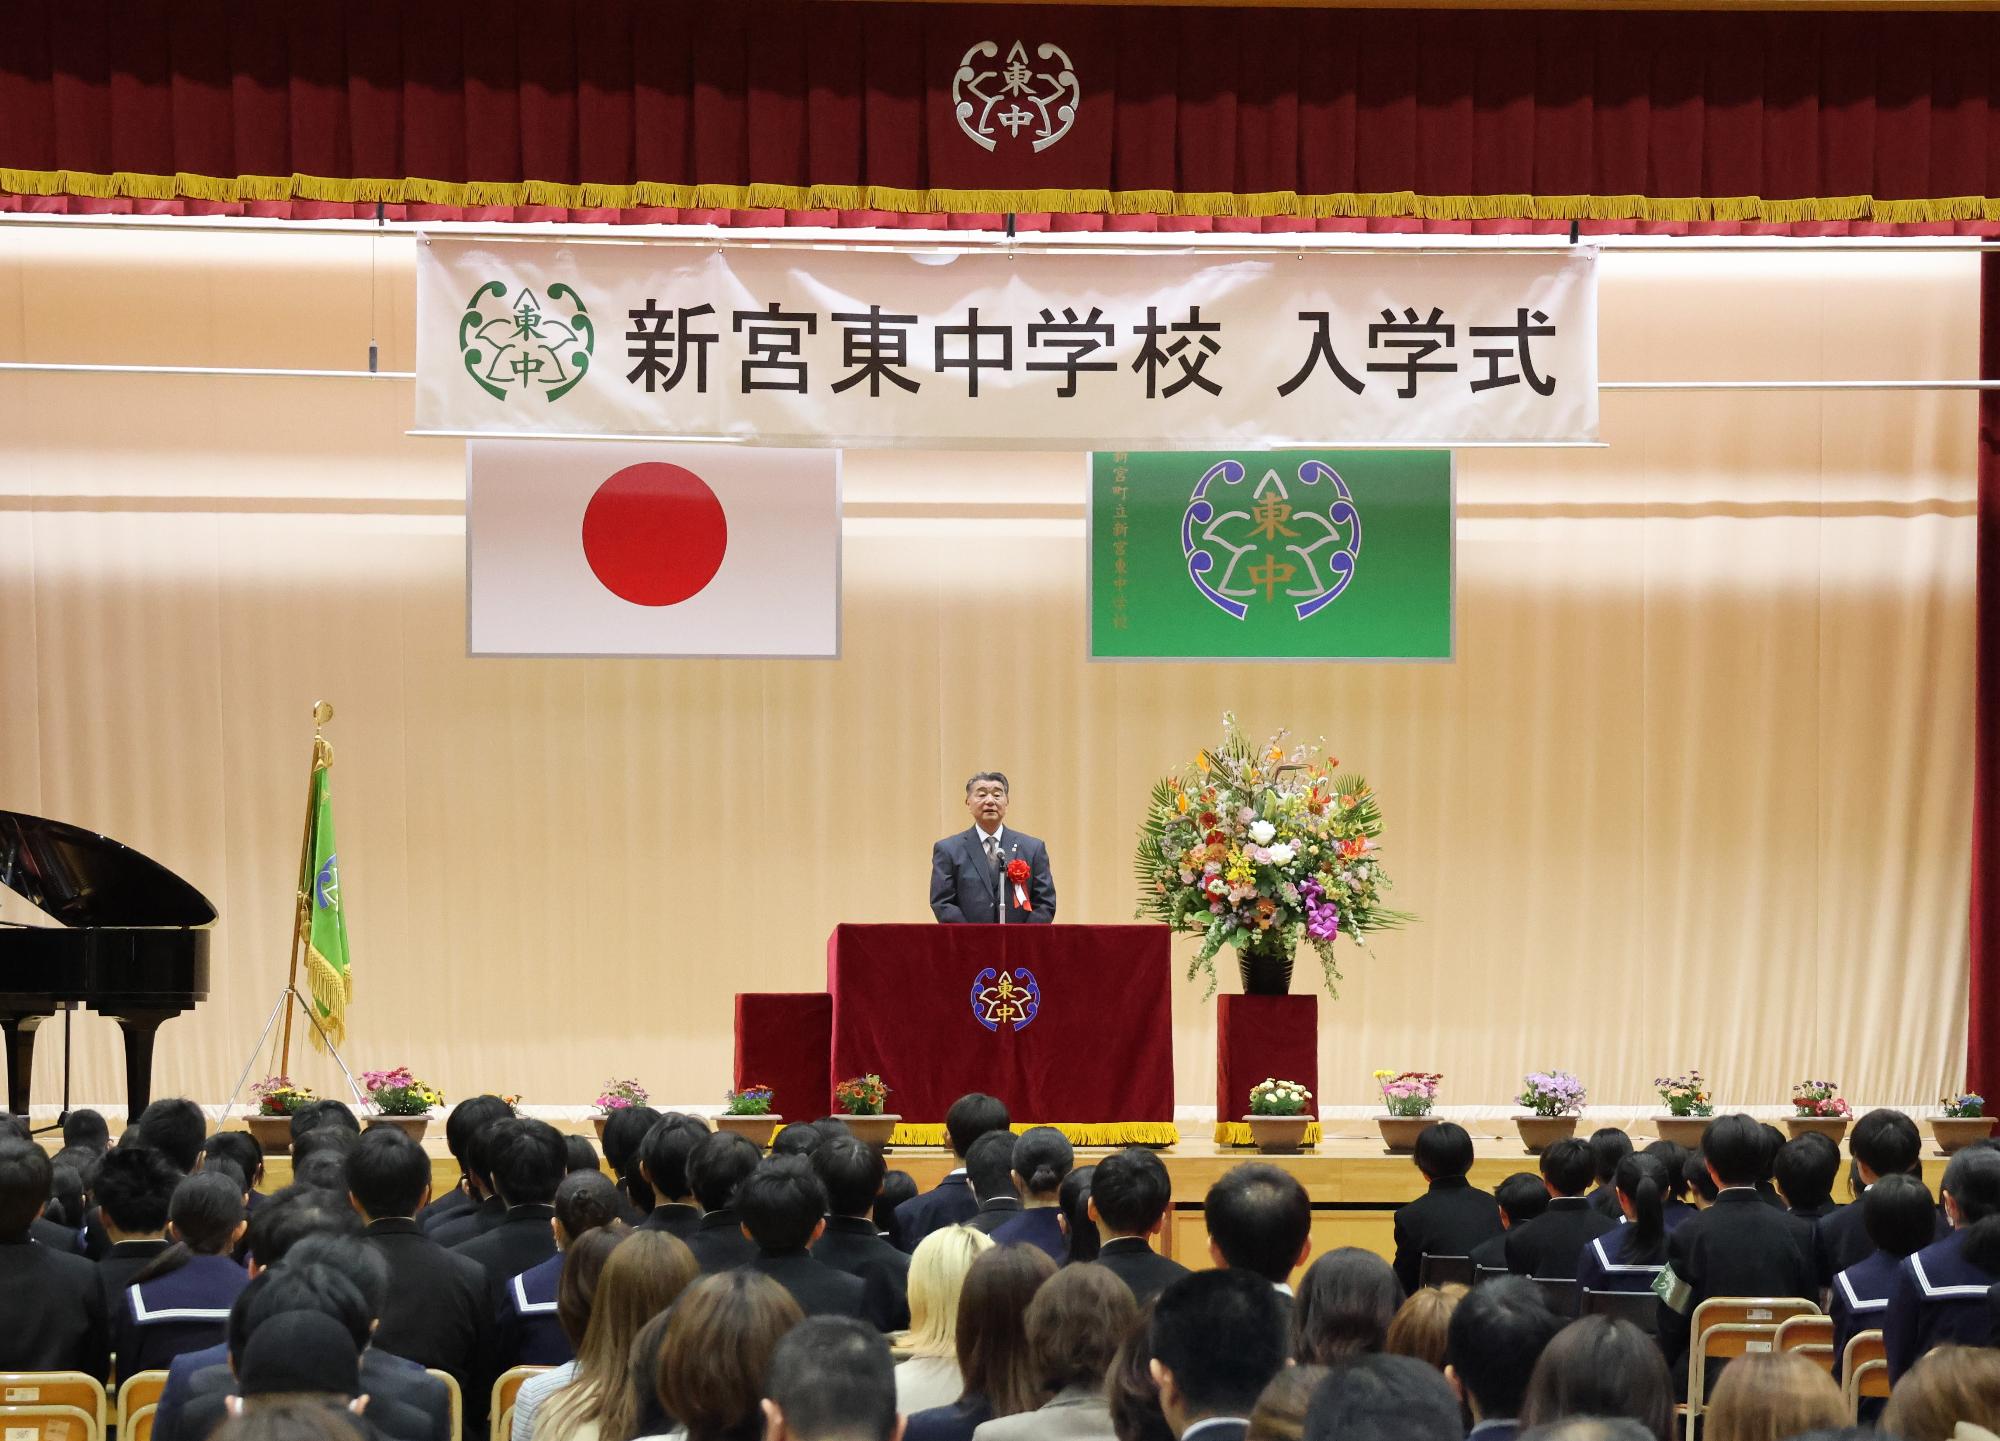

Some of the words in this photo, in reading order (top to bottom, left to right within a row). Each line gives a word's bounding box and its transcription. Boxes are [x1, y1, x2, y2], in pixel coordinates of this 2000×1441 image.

[626, 299, 1223, 398] 新宮東中学校
[1277, 307, 1557, 398] 入学式
